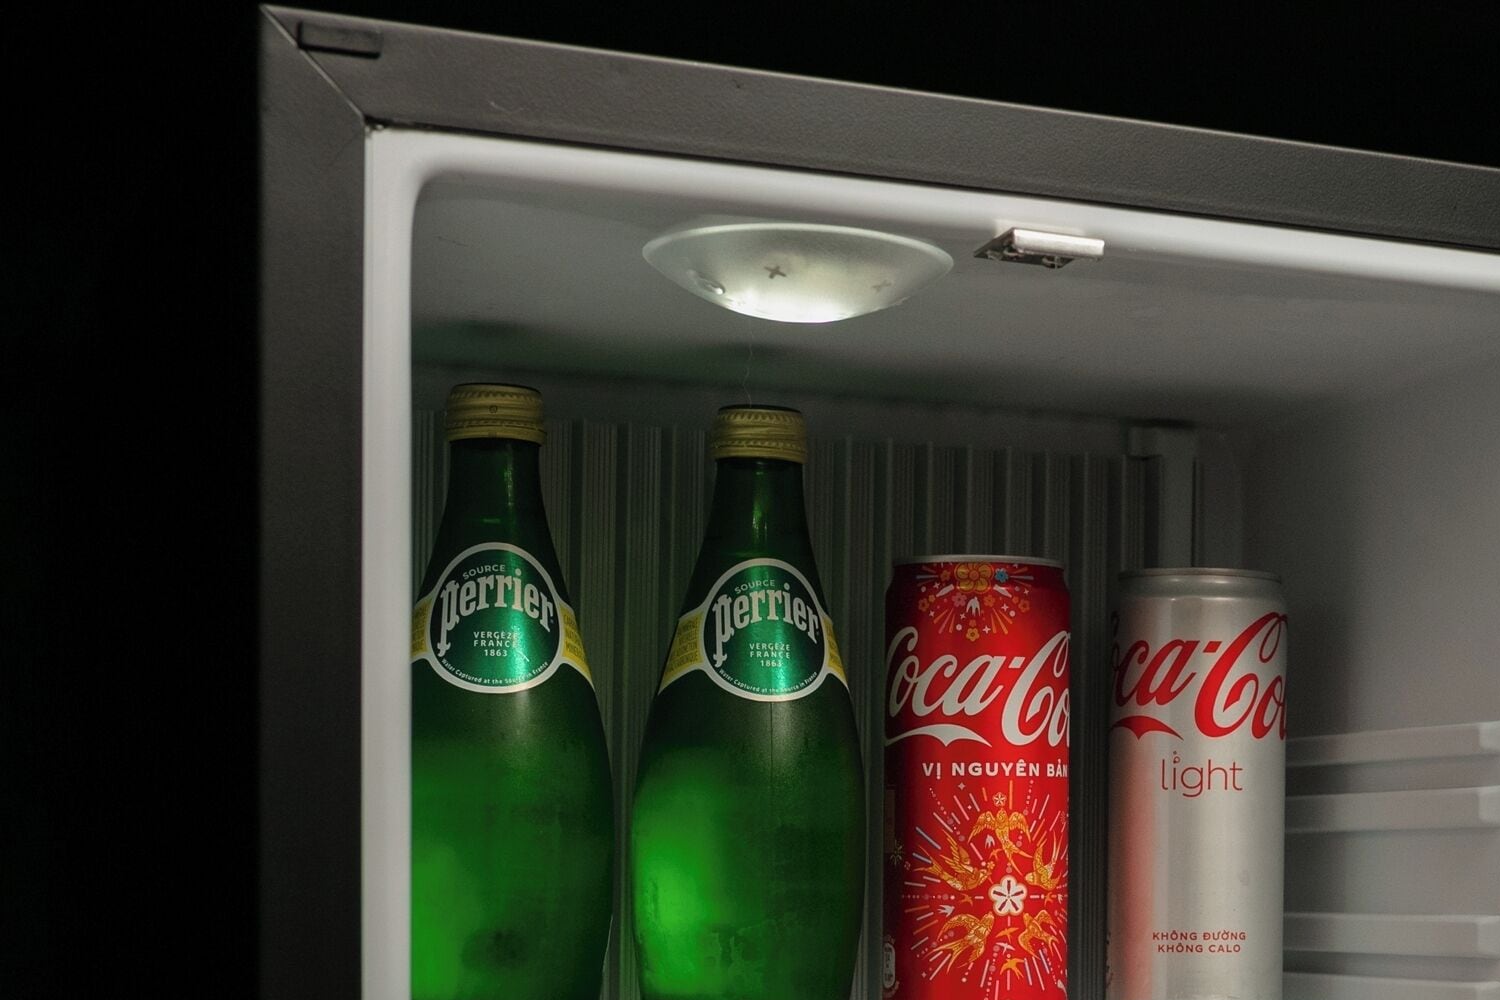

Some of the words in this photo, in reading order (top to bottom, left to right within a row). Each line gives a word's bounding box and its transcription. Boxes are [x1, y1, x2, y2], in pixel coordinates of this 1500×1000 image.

[462, 564, 506, 580] SOURCE
[734, 580, 776, 594] SOURCE
[473, 639, 517, 648] FRANCE
[484, 649, 508, 657] 1863
[749, 651, 790, 659] FRANCE
[455, 669, 482, 683] Captured
[532, 661, 549, 674] France
[733, 679, 759, 692] Captured
[804, 671, 818, 684] France
[922, 762, 942, 779] VỊ
[951, 759, 1040, 776] NGUYÊN
[1161, 751, 1243, 797] light
[1152, 930, 1198, 941] KHÔNG
[1203, 930, 1246, 941] ĐƯỜNG
[1157, 943, 1203, 953] KHÔNG
[1208, 944, 1241, 953] CALO
